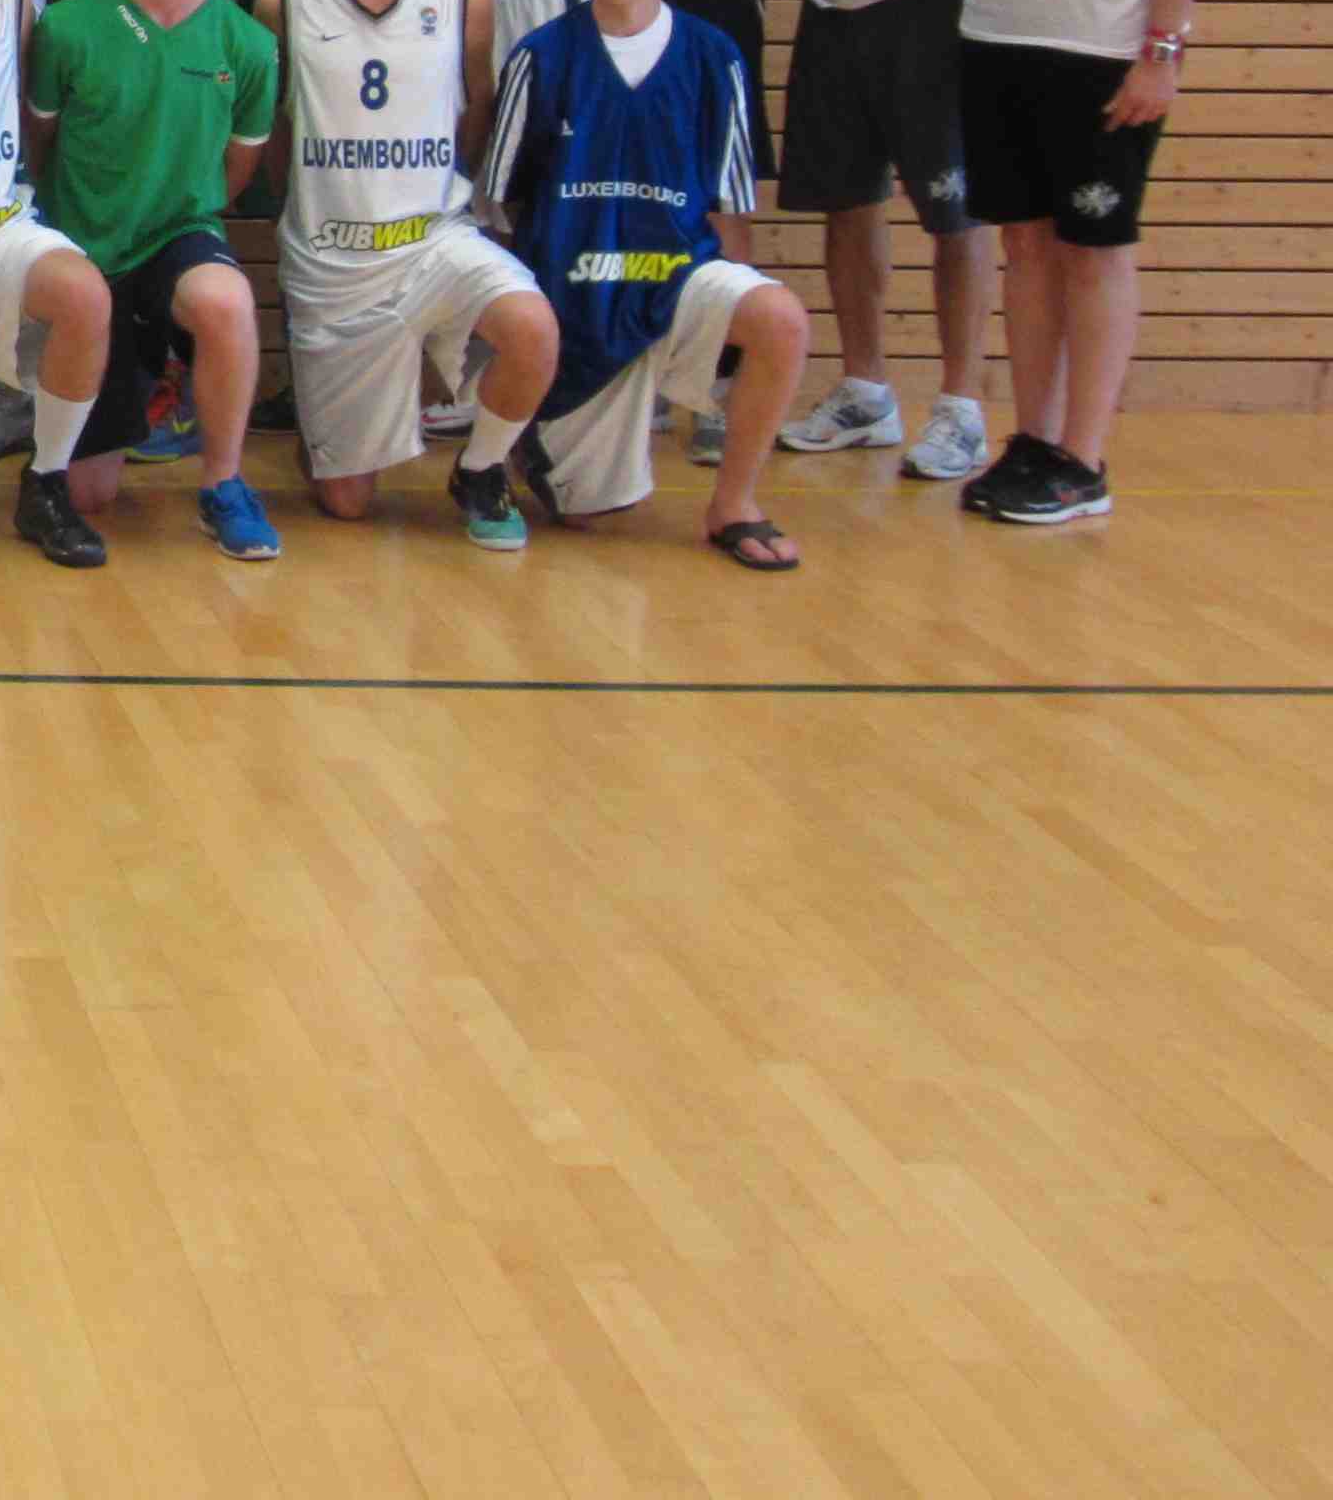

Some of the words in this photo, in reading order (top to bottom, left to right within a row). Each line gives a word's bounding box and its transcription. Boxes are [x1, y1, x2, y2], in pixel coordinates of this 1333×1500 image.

[360, 57, 389, 111] 8
[303, 136, 452, 170] LUXEMBOURG
[311, 213, 436, 254] SUBWAY
[568, 252, 694, 284] SUBWAY
